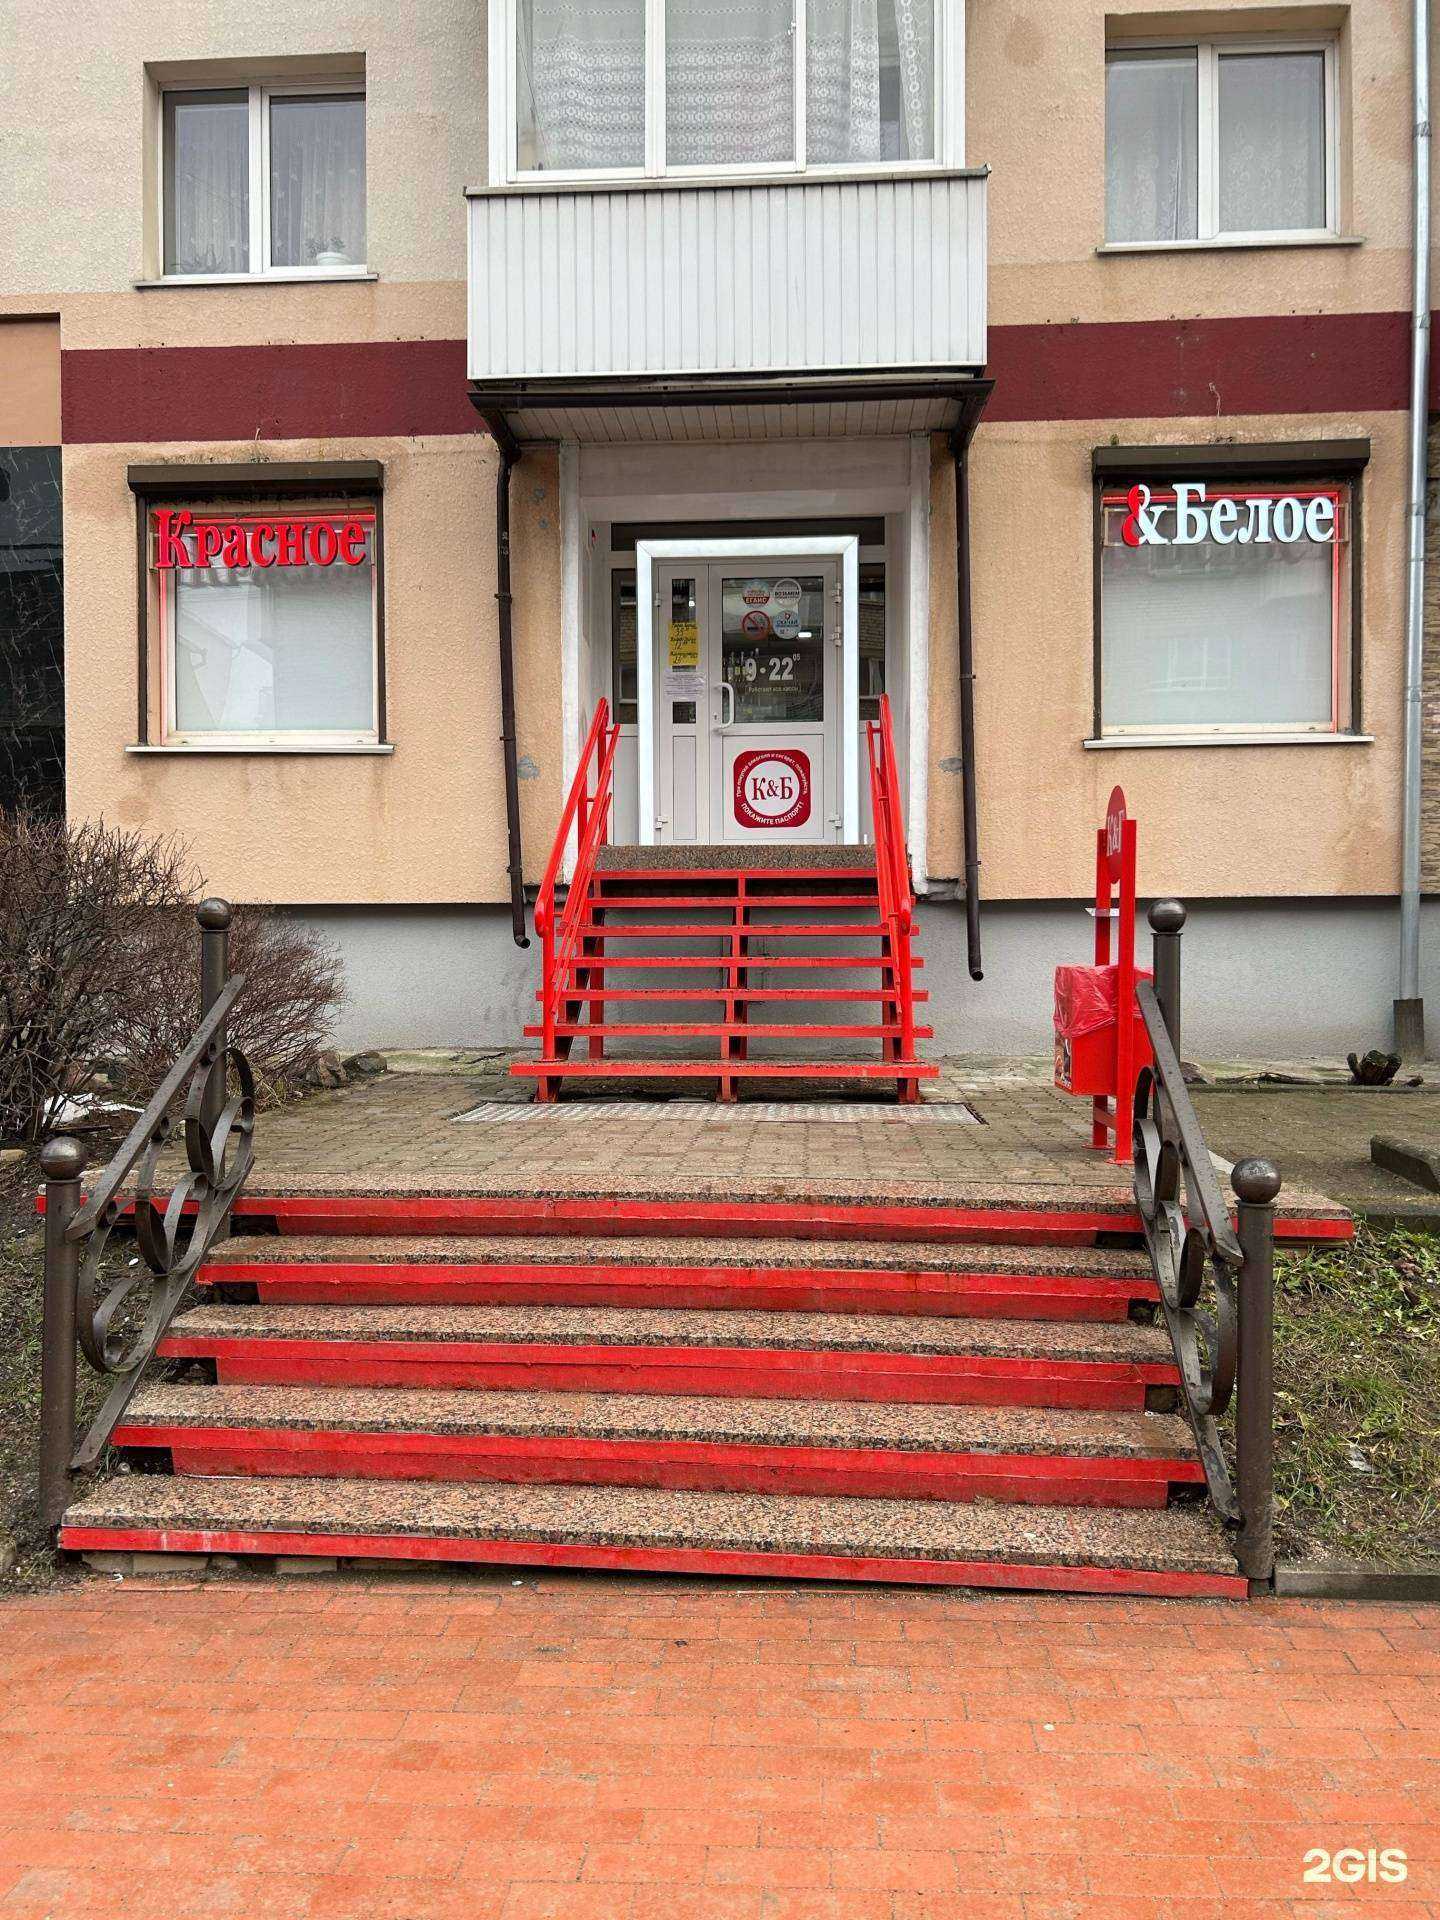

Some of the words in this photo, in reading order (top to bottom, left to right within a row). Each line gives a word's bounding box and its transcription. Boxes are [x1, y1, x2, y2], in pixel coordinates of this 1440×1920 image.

[153, 509, 367, 568] Красное
[751, 776, 794, 801] К&Б
[741, 802, 774, 825] ПОКАЖИТЕ
[774, 801, 805, 825] ПАСПОРТ!
